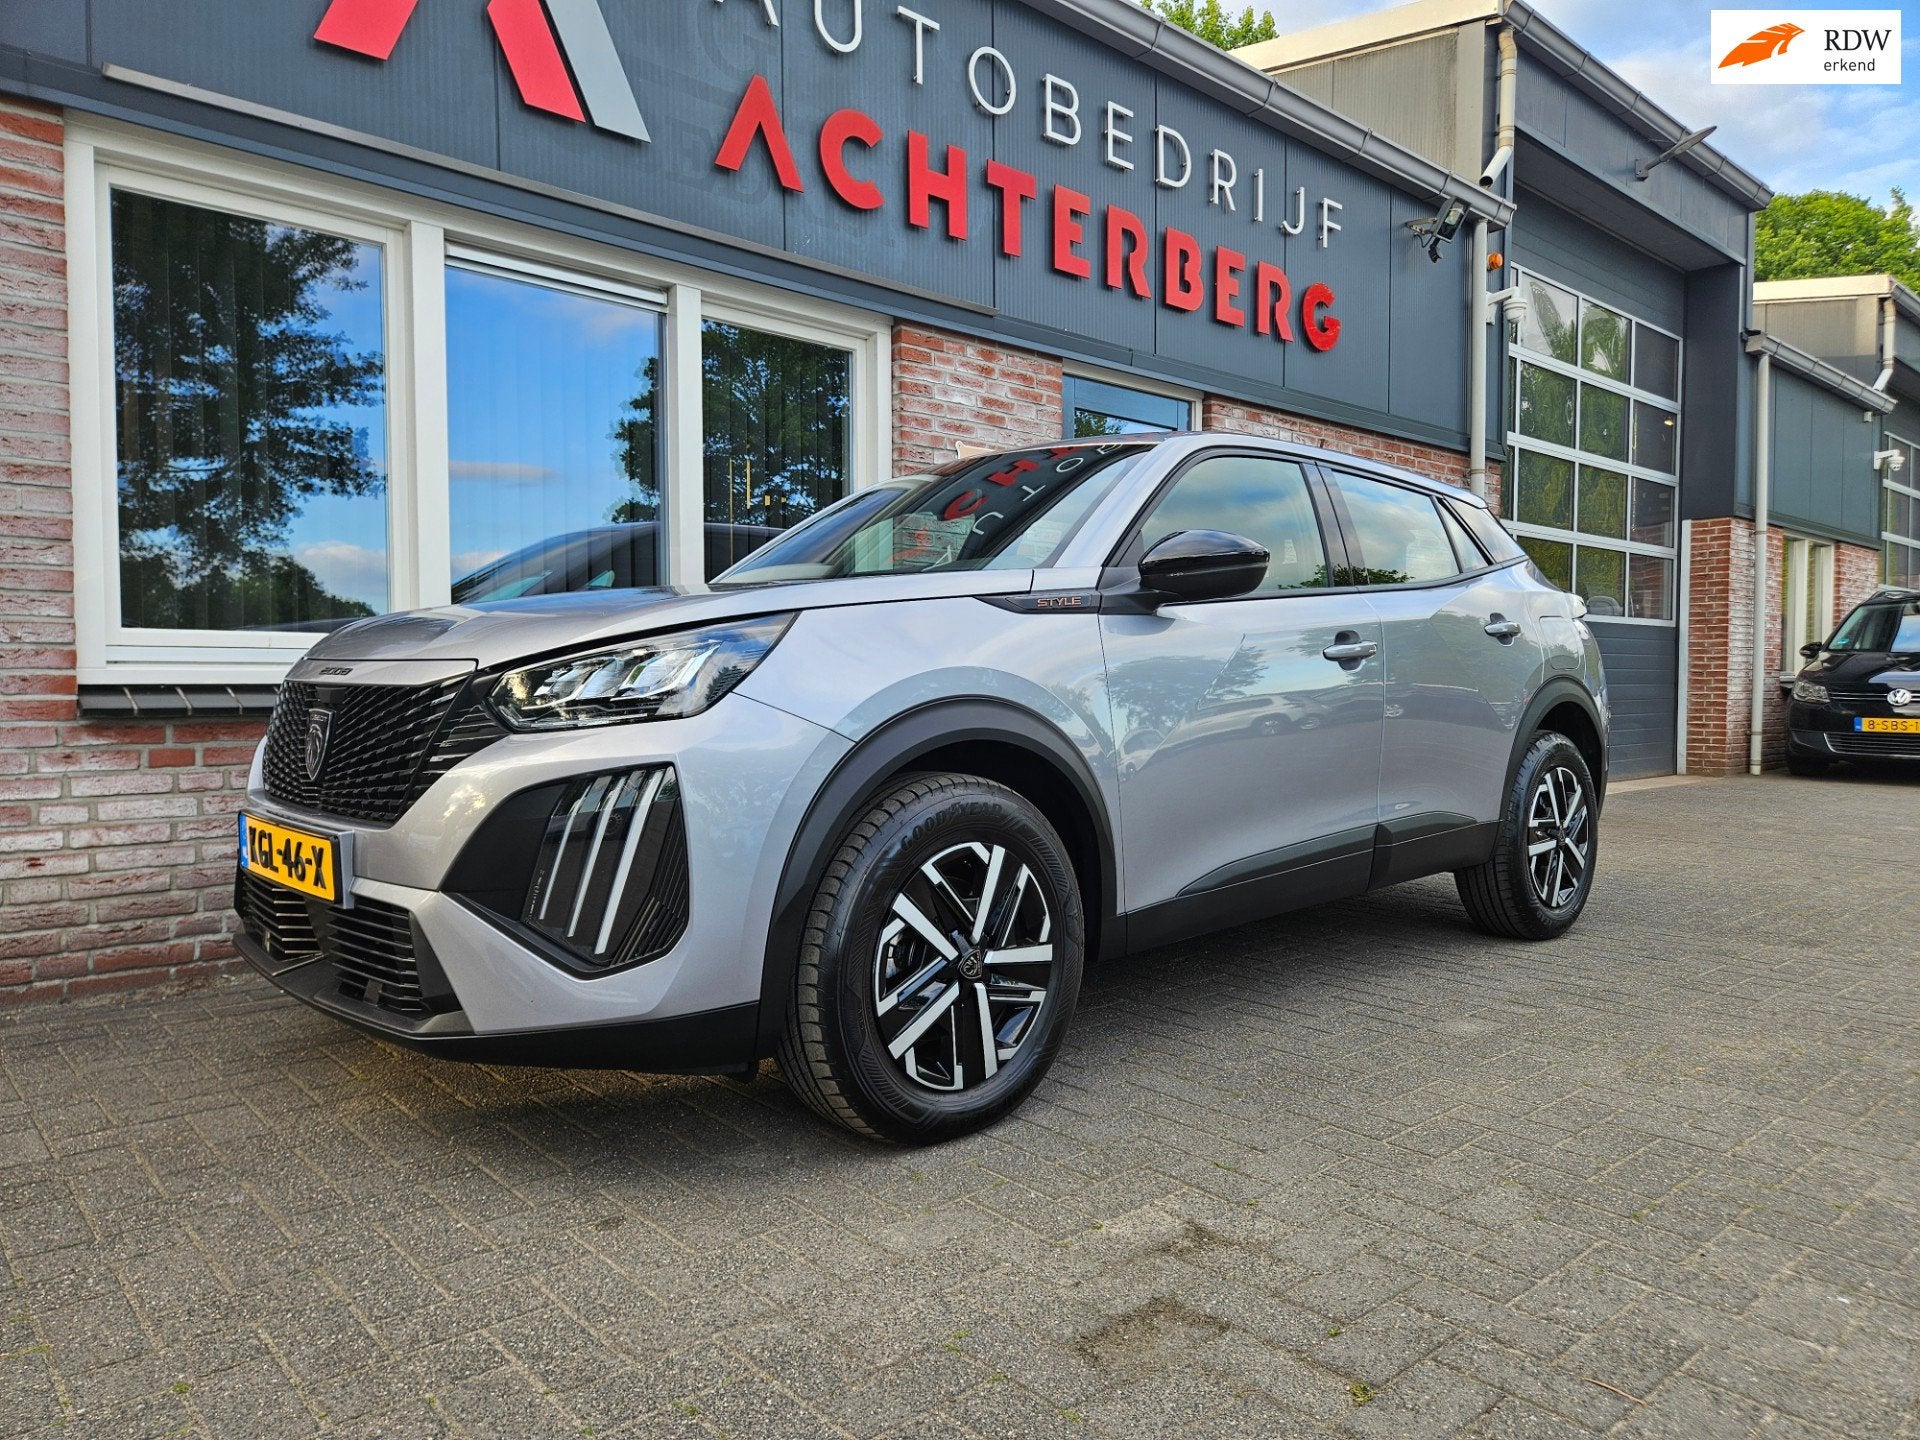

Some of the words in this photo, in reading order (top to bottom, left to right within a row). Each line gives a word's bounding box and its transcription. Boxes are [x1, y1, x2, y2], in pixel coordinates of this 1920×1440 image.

[713, 0, 1343, 248] UTOBEDRIJF
[715, 74, 1342, 352] ACHTERBERG
[1037, 596, 1082, 608] STYLE
[248, 825, 327, 890] KGL-46-X
